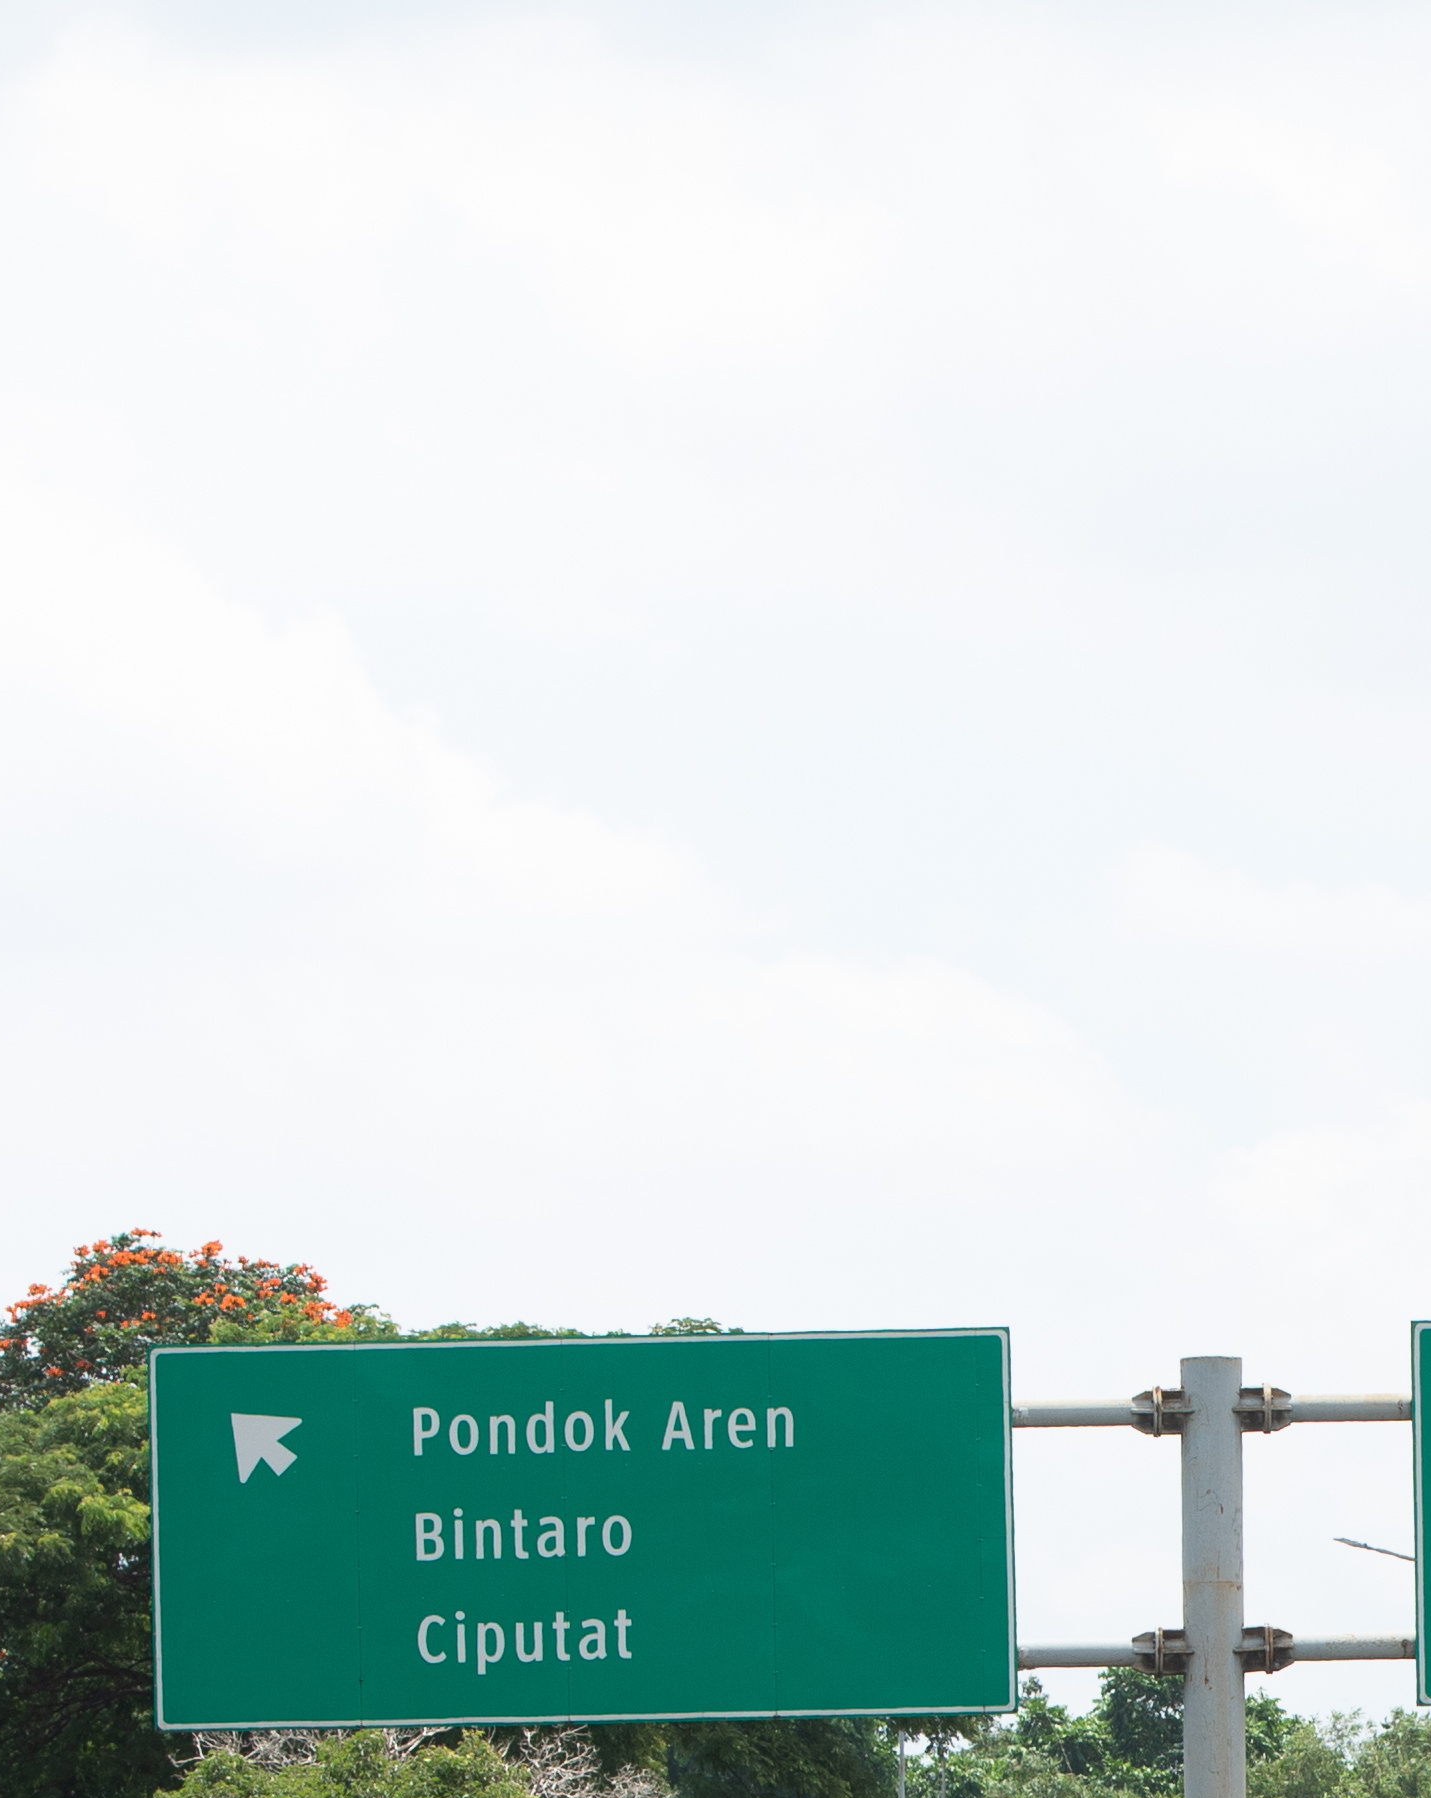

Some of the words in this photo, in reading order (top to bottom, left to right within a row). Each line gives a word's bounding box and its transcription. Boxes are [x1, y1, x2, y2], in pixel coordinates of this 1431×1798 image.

[412, 1399, 632, 1457] Pondok
[661, 1400, 796, 1452] Aren
[415, 1507, 634, 1562] Bintaro
[417, 1608, 634, 1675] Ciputat
